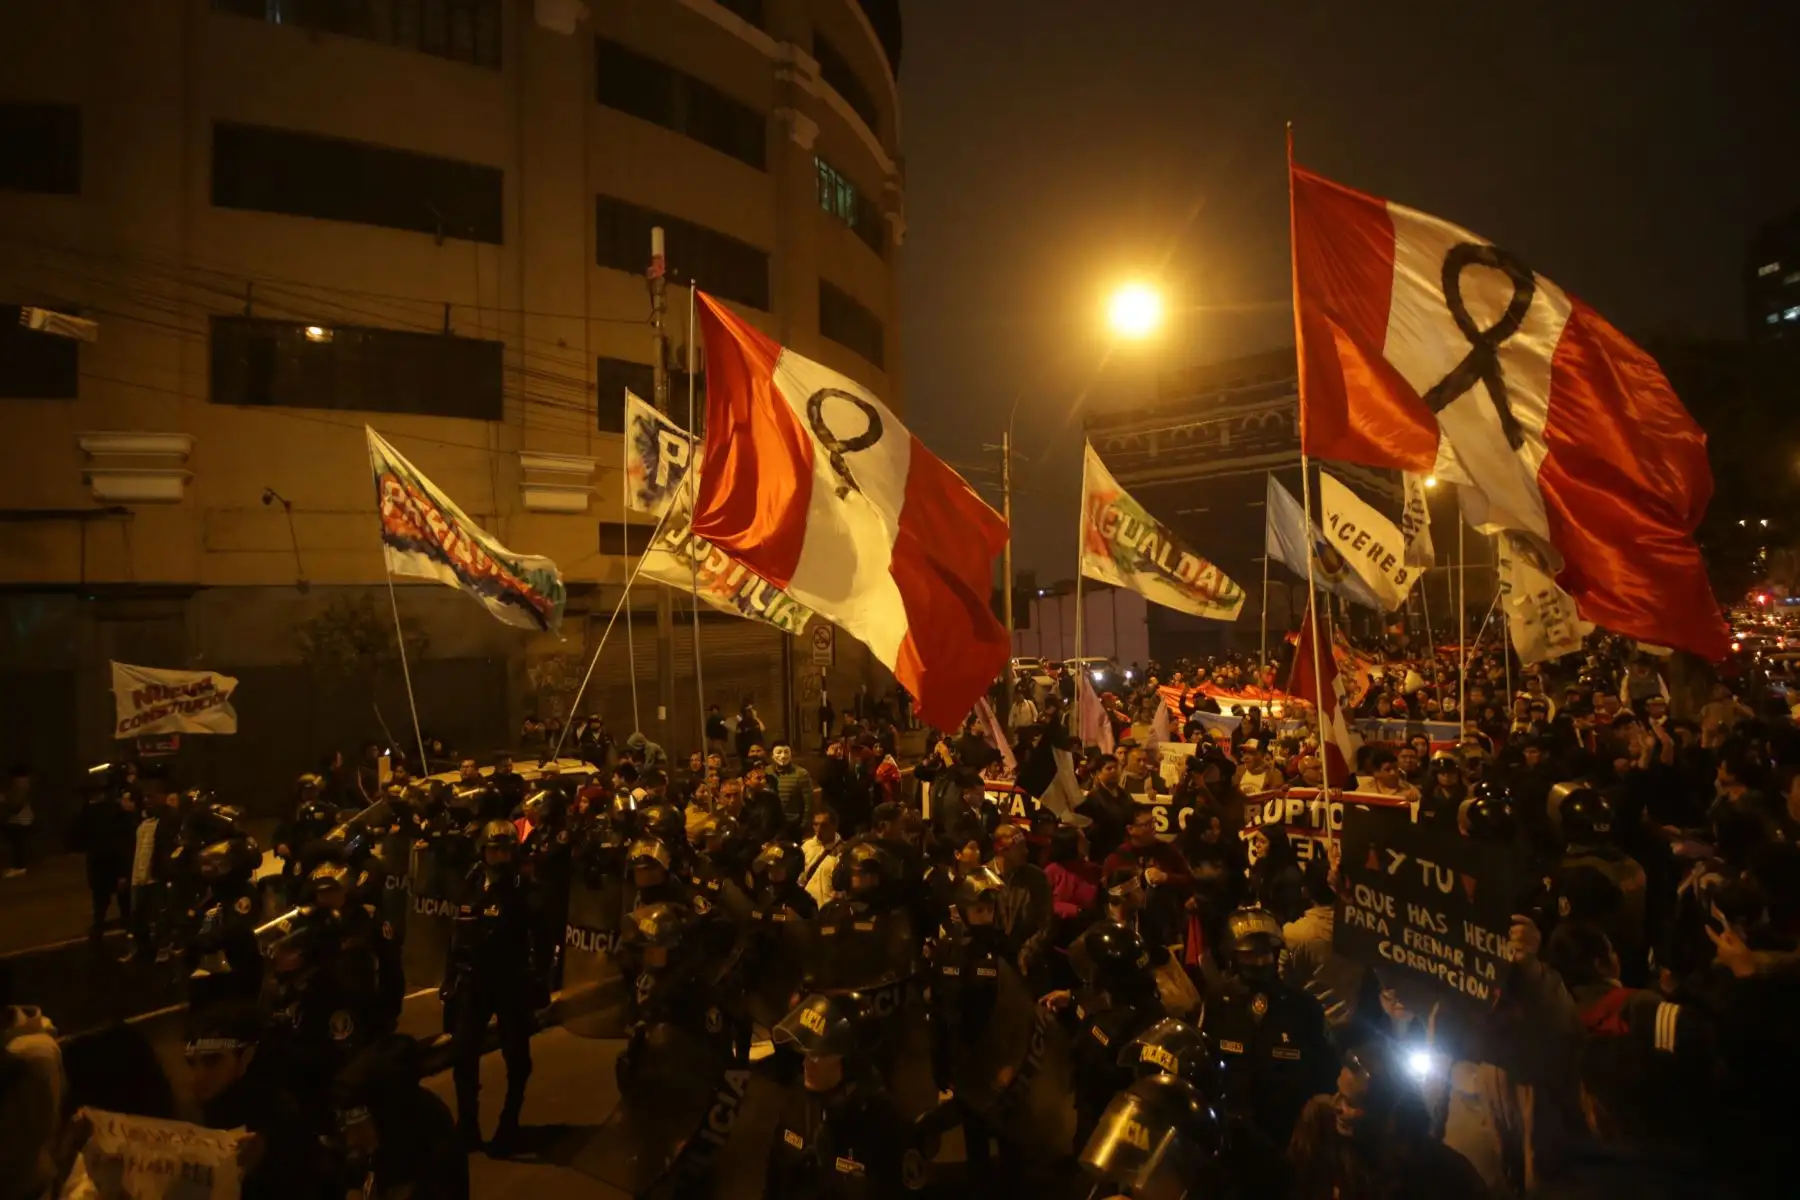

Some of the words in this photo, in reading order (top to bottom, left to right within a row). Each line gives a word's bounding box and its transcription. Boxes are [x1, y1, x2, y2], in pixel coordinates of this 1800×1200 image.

[1415, 857, 1455, 894] TU
[1354, 884, 1396, 919] QUE
[1407, 902, 1449, 935] HAS
[1344, 905, 1390, 937] PARA
[1403, 927, 1465, 968] FRENAR
[1475, 956, 1496, 981] LA
